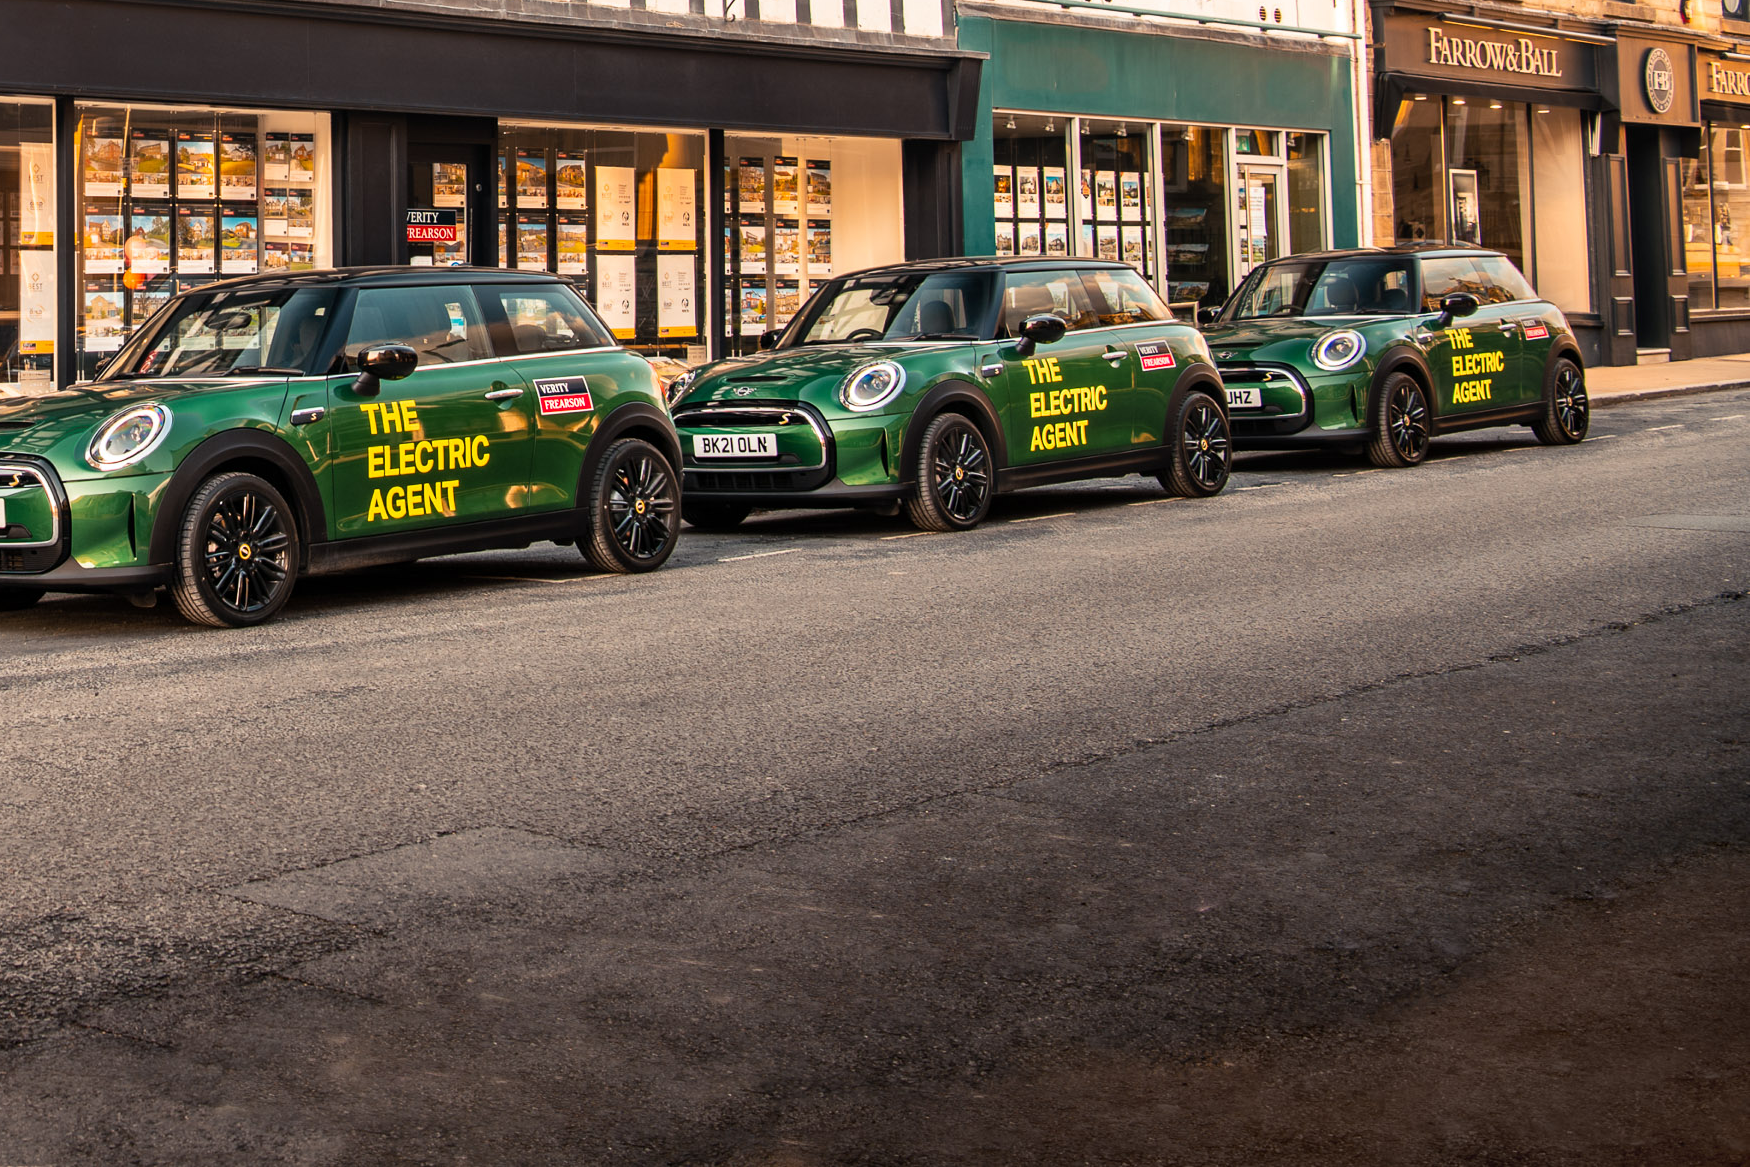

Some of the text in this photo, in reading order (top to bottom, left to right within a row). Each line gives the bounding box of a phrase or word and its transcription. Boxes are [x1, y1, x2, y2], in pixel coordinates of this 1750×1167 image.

[1445, 327, 1474, 350] THE
[1021, 357, 1063, 385] THE
[1451, 350, 1505, 377] ELECTRIC
[539, 382, 569, 394] VERITY
[1452, 379, 1492, 405] AGENT
[544, 397, 586, 410] FREARSON
[1030, 385, 1108, 419] ELECTRIC
[359, 399, 420, 435] THE
[702, 436, 768, 453] BK21 OLN
[1030, 419, 1089, 452] AGENT
[367, 434, 490, 479] ELECTRIC
[367, 479, 460, 522] AGENT
